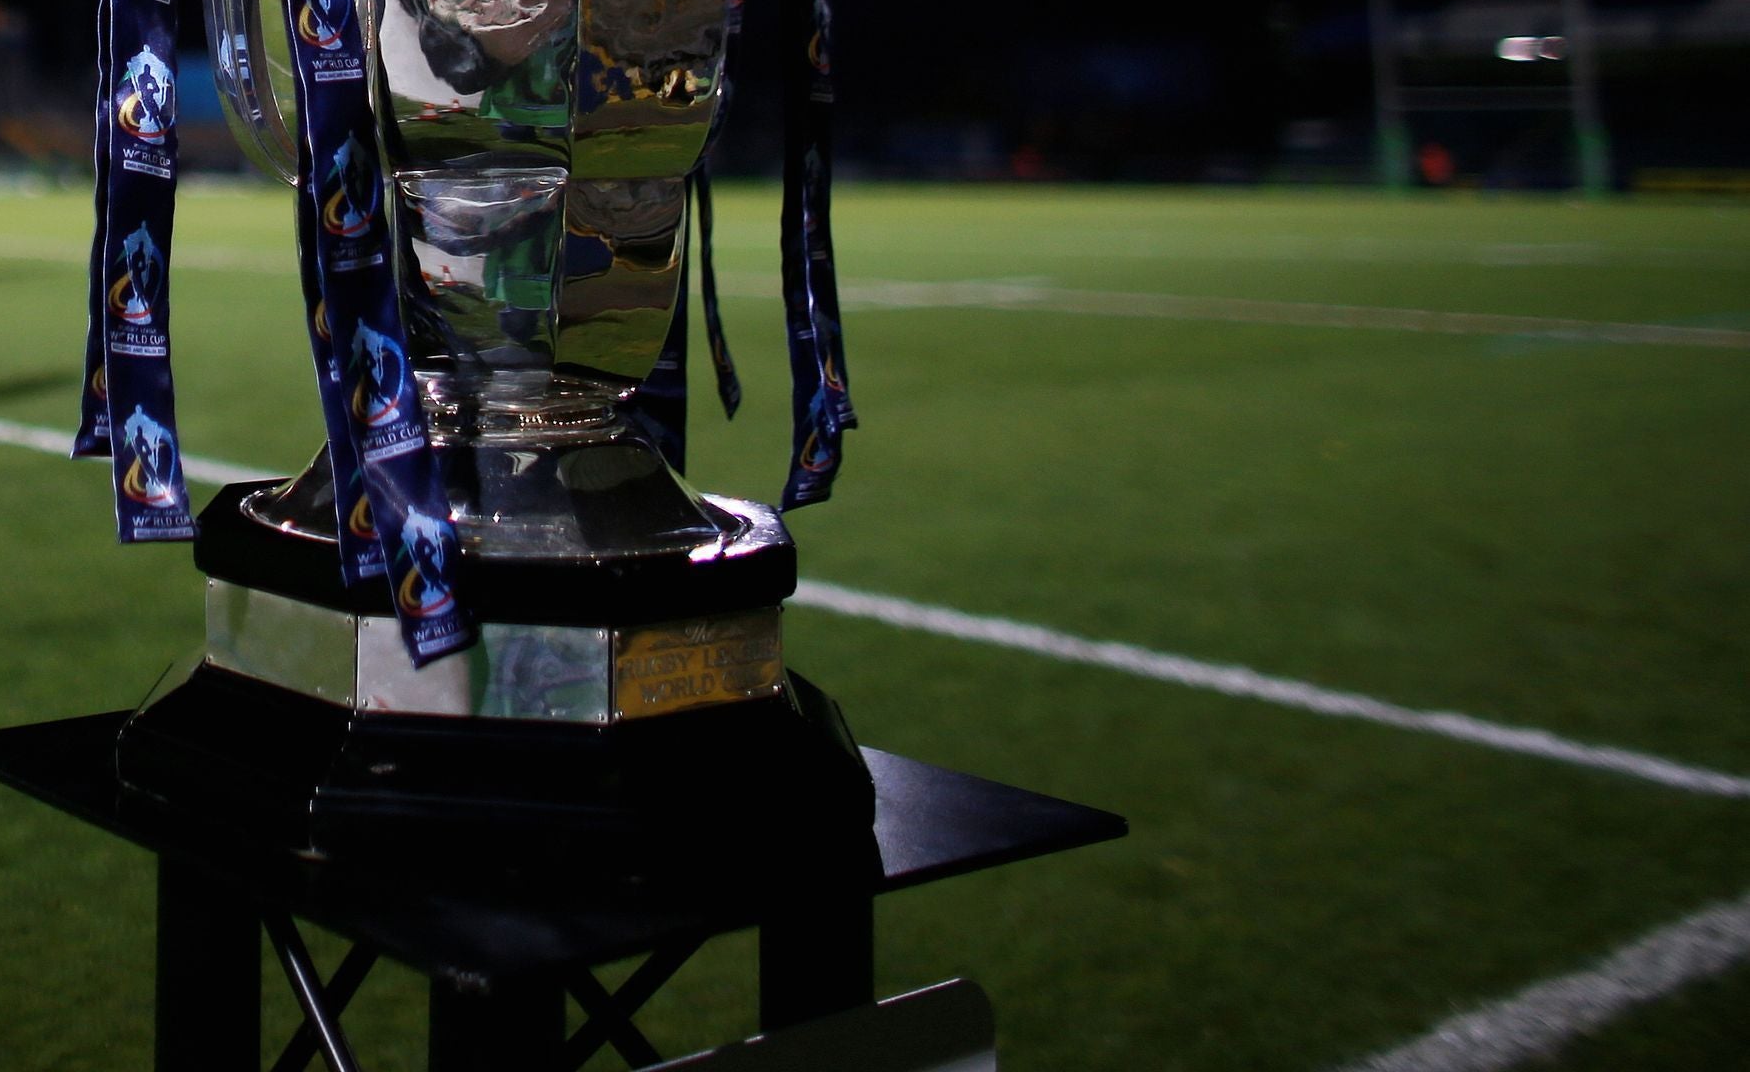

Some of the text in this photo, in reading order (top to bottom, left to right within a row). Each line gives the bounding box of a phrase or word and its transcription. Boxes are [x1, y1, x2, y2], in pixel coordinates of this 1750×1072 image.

[344, 58, 360, 69] CUP
[149, 334, 166, 345] CUP
[399, 424, 422, 440] CUP
